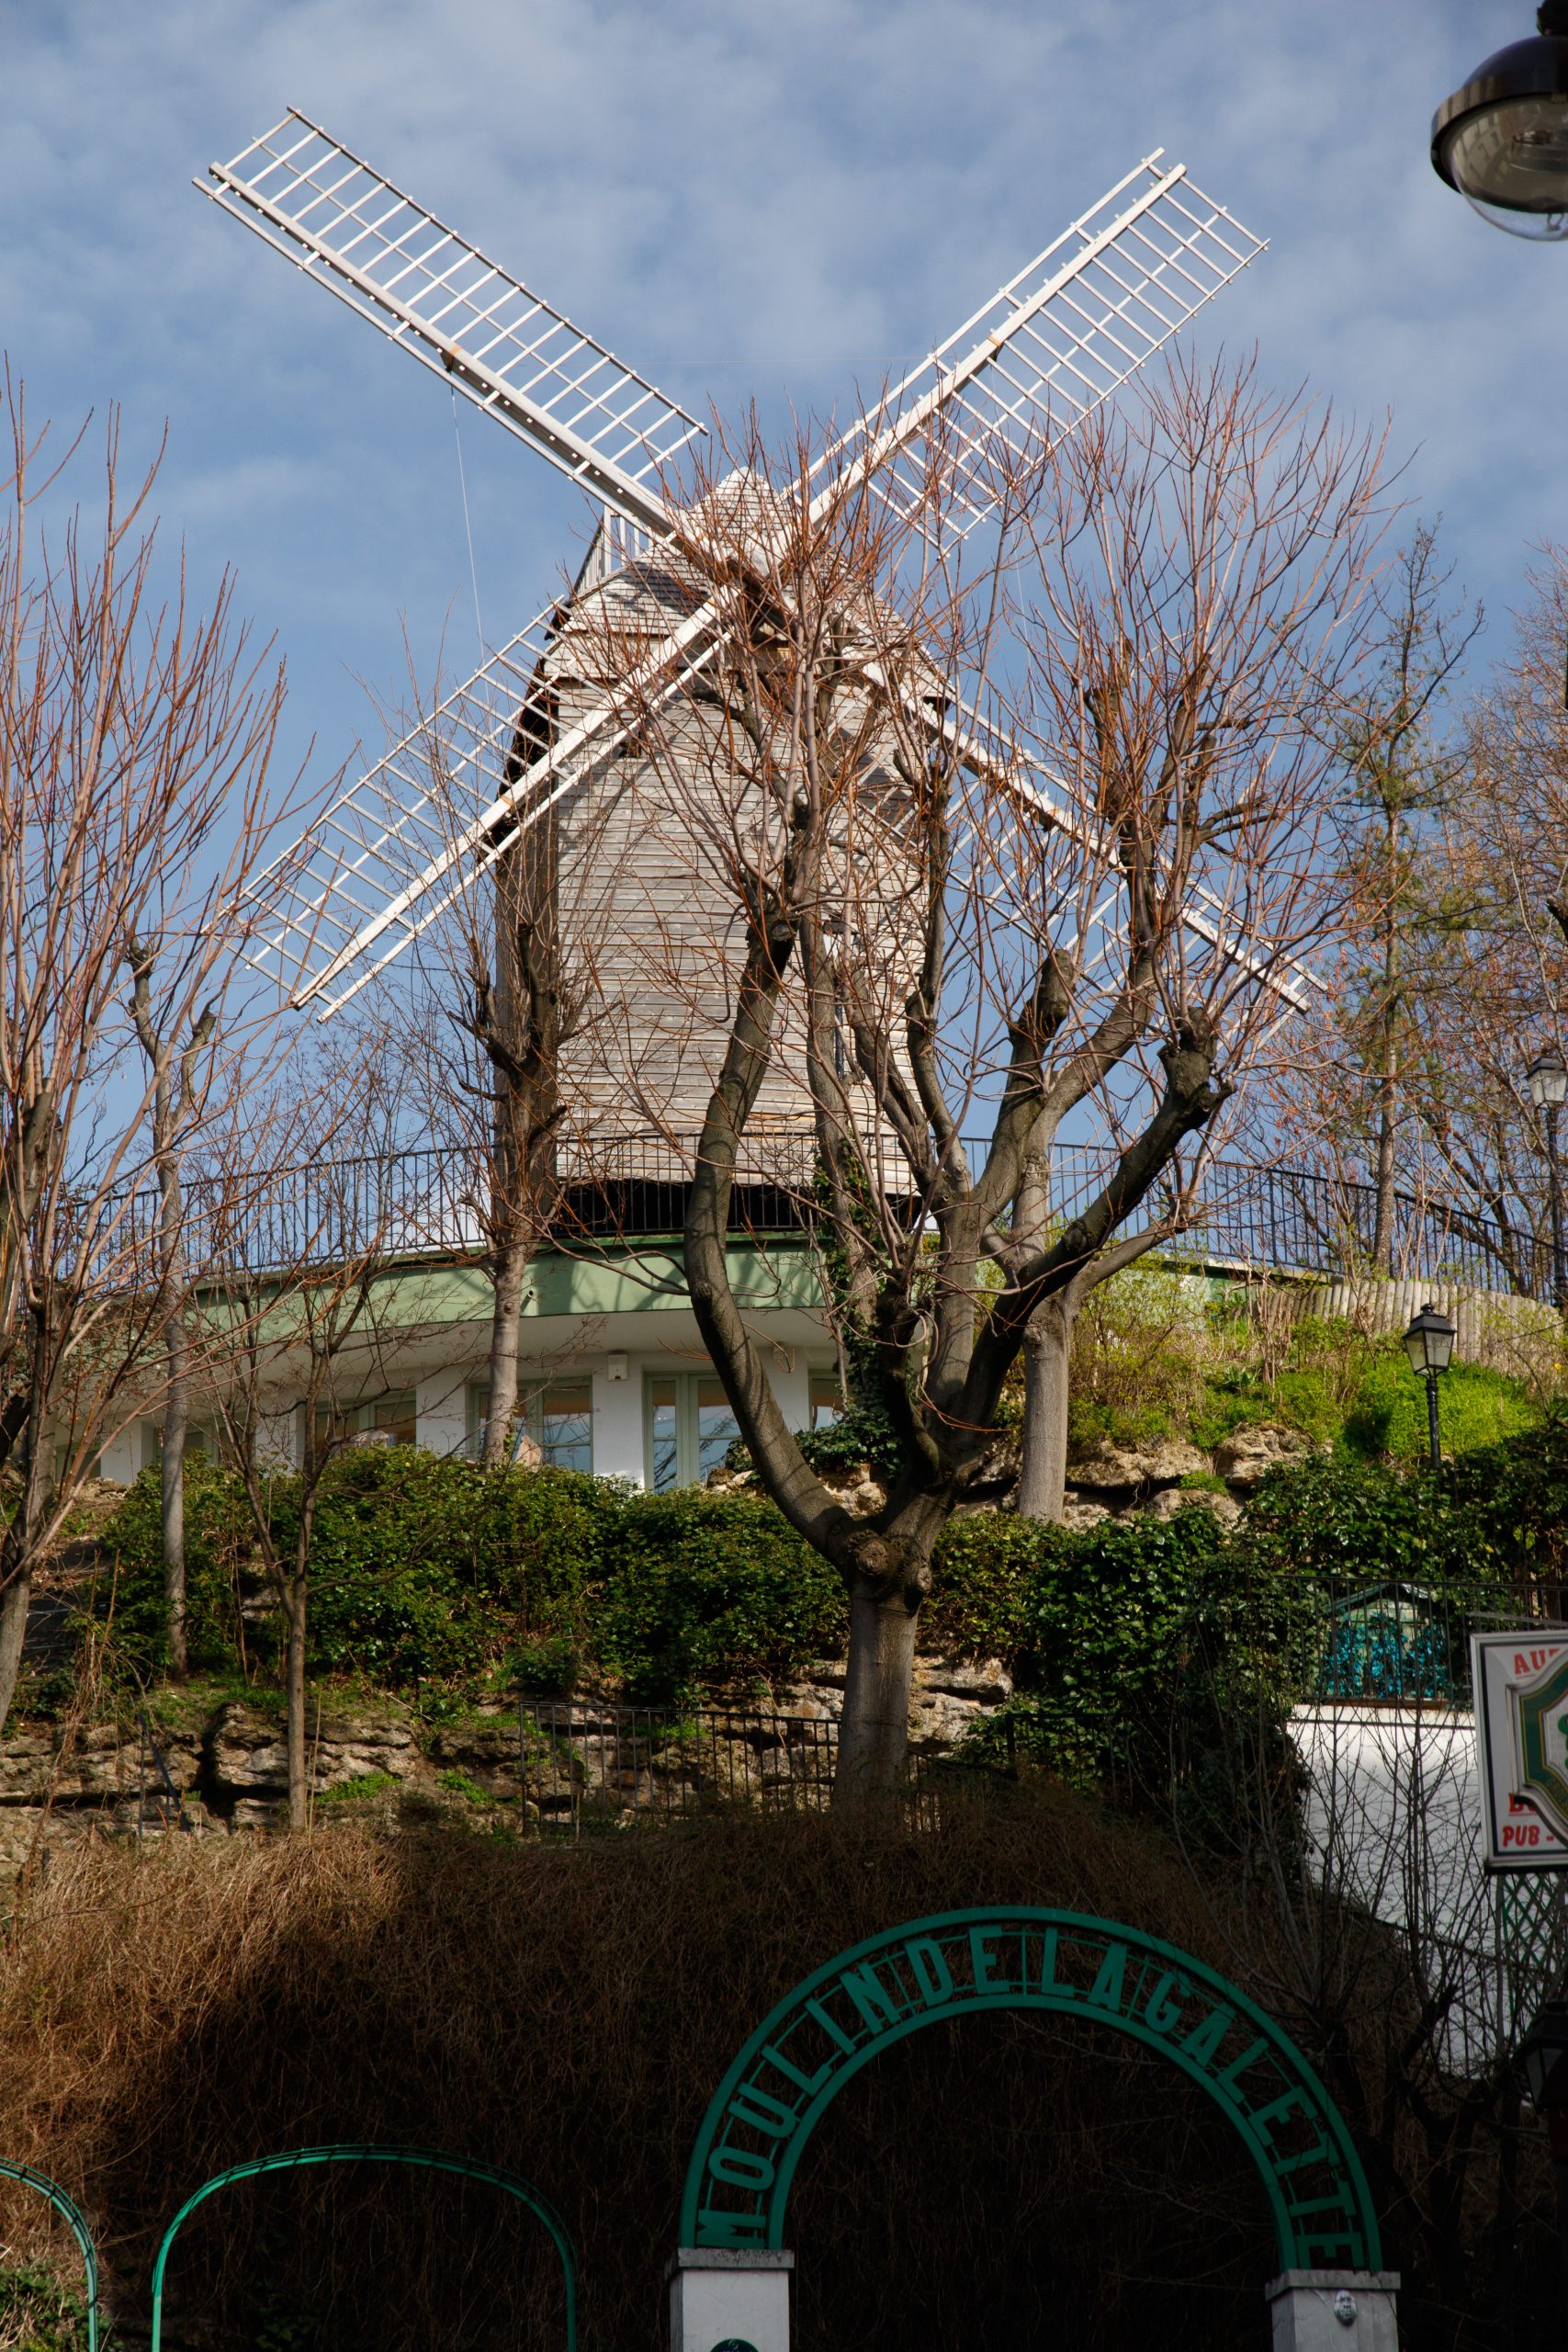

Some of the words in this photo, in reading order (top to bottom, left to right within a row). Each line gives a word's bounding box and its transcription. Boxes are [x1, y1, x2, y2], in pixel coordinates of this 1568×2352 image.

[1502, 1825, 1540, 1848] PUB
[697, 1965, 901, 2249] MOULIN
[905, 1926, 1010, 2007] DE
[1041, 1927, 1127, 2012] LA
[1146, 1974, 1365, 2268] GALETTE
